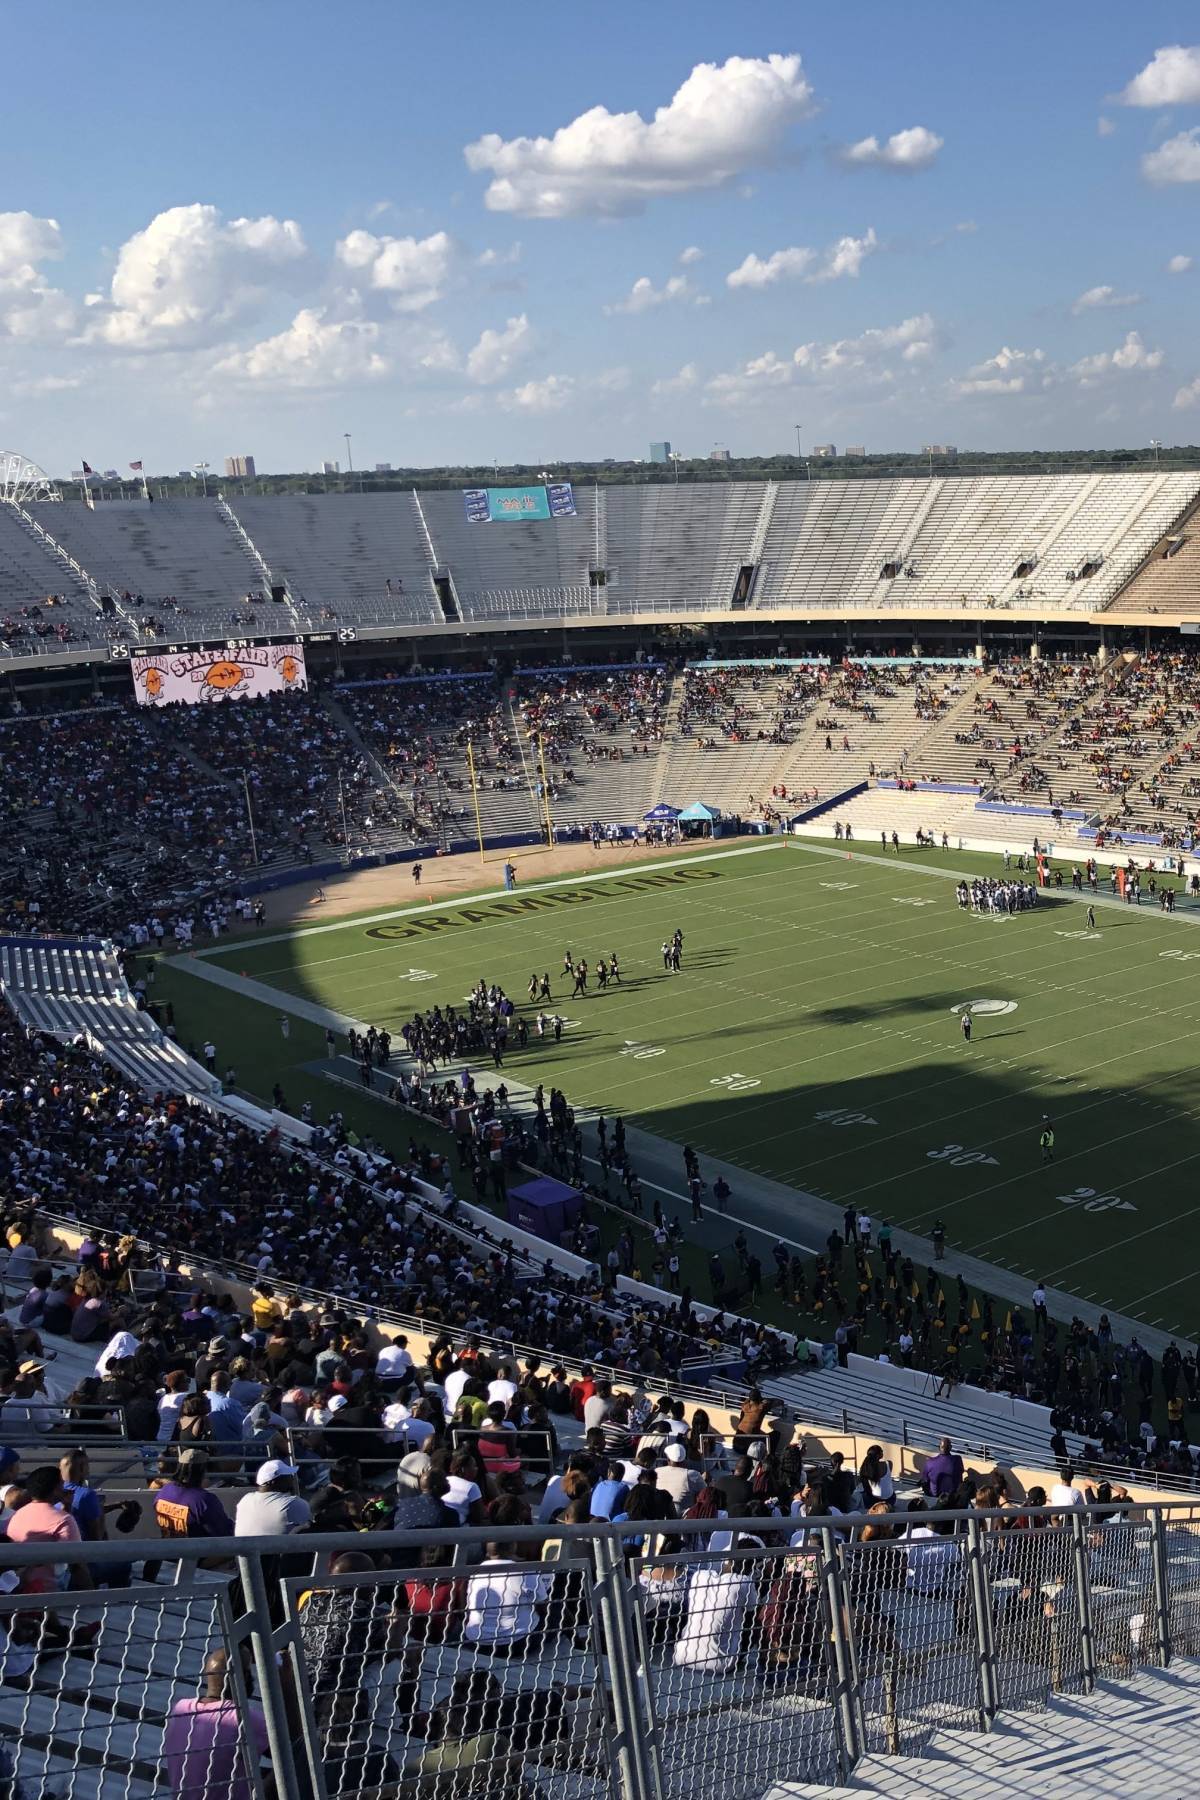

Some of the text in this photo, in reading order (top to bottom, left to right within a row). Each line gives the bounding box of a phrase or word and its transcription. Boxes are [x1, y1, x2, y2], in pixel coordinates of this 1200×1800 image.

[340, 628, 356, 640] 25
[112, 644, 128, 658] 25
[226, 640, 247, 649] 10:14
[170, 647, 268, 677] STATE FAIR
[364, 867, 725, 942] GRAMBLING
[709, 1072, 762, 1091] 50
[813, 1108, 867, 1126] 40
[926, 1144, 985, 1167] 30
[1055, 1186, 1122, 1213] 20
